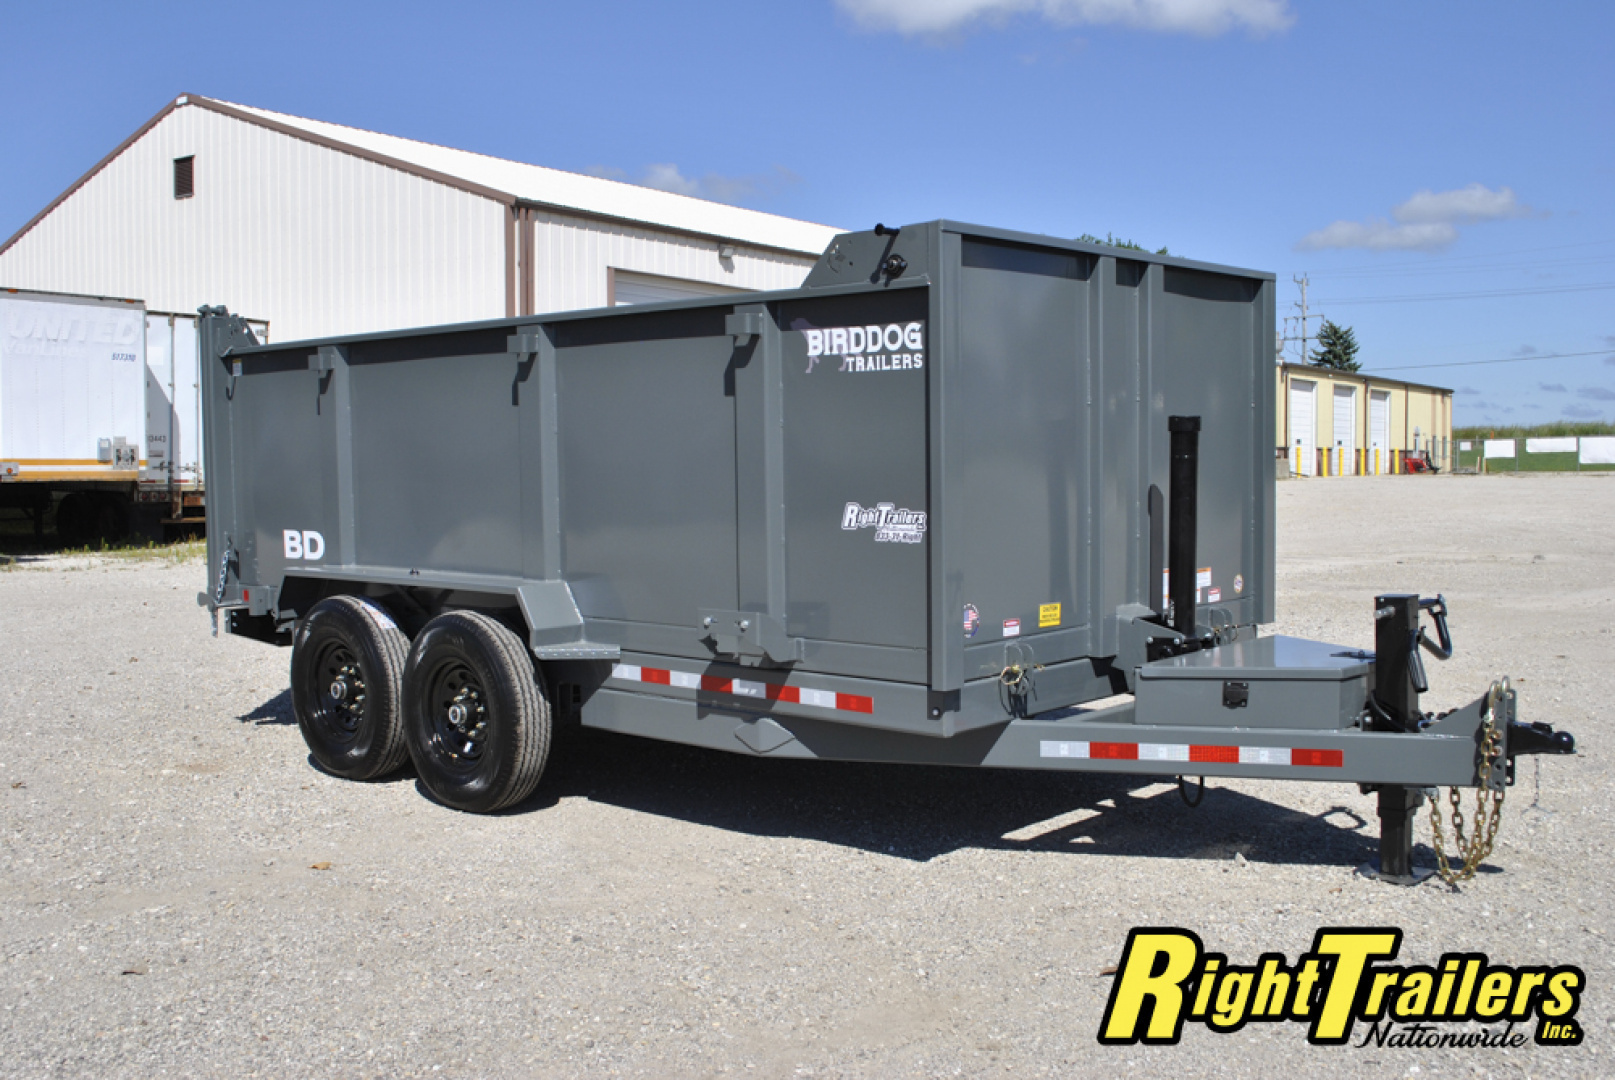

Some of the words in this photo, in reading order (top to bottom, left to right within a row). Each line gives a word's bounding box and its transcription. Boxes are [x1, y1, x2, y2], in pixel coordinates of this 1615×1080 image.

[9, 314, 141, 345] UNITED
[807, 322, 923, 356] BIRDDOG
[846, 353, 923, 372] TRAILERS
[283, 529, 325, 560] BD
